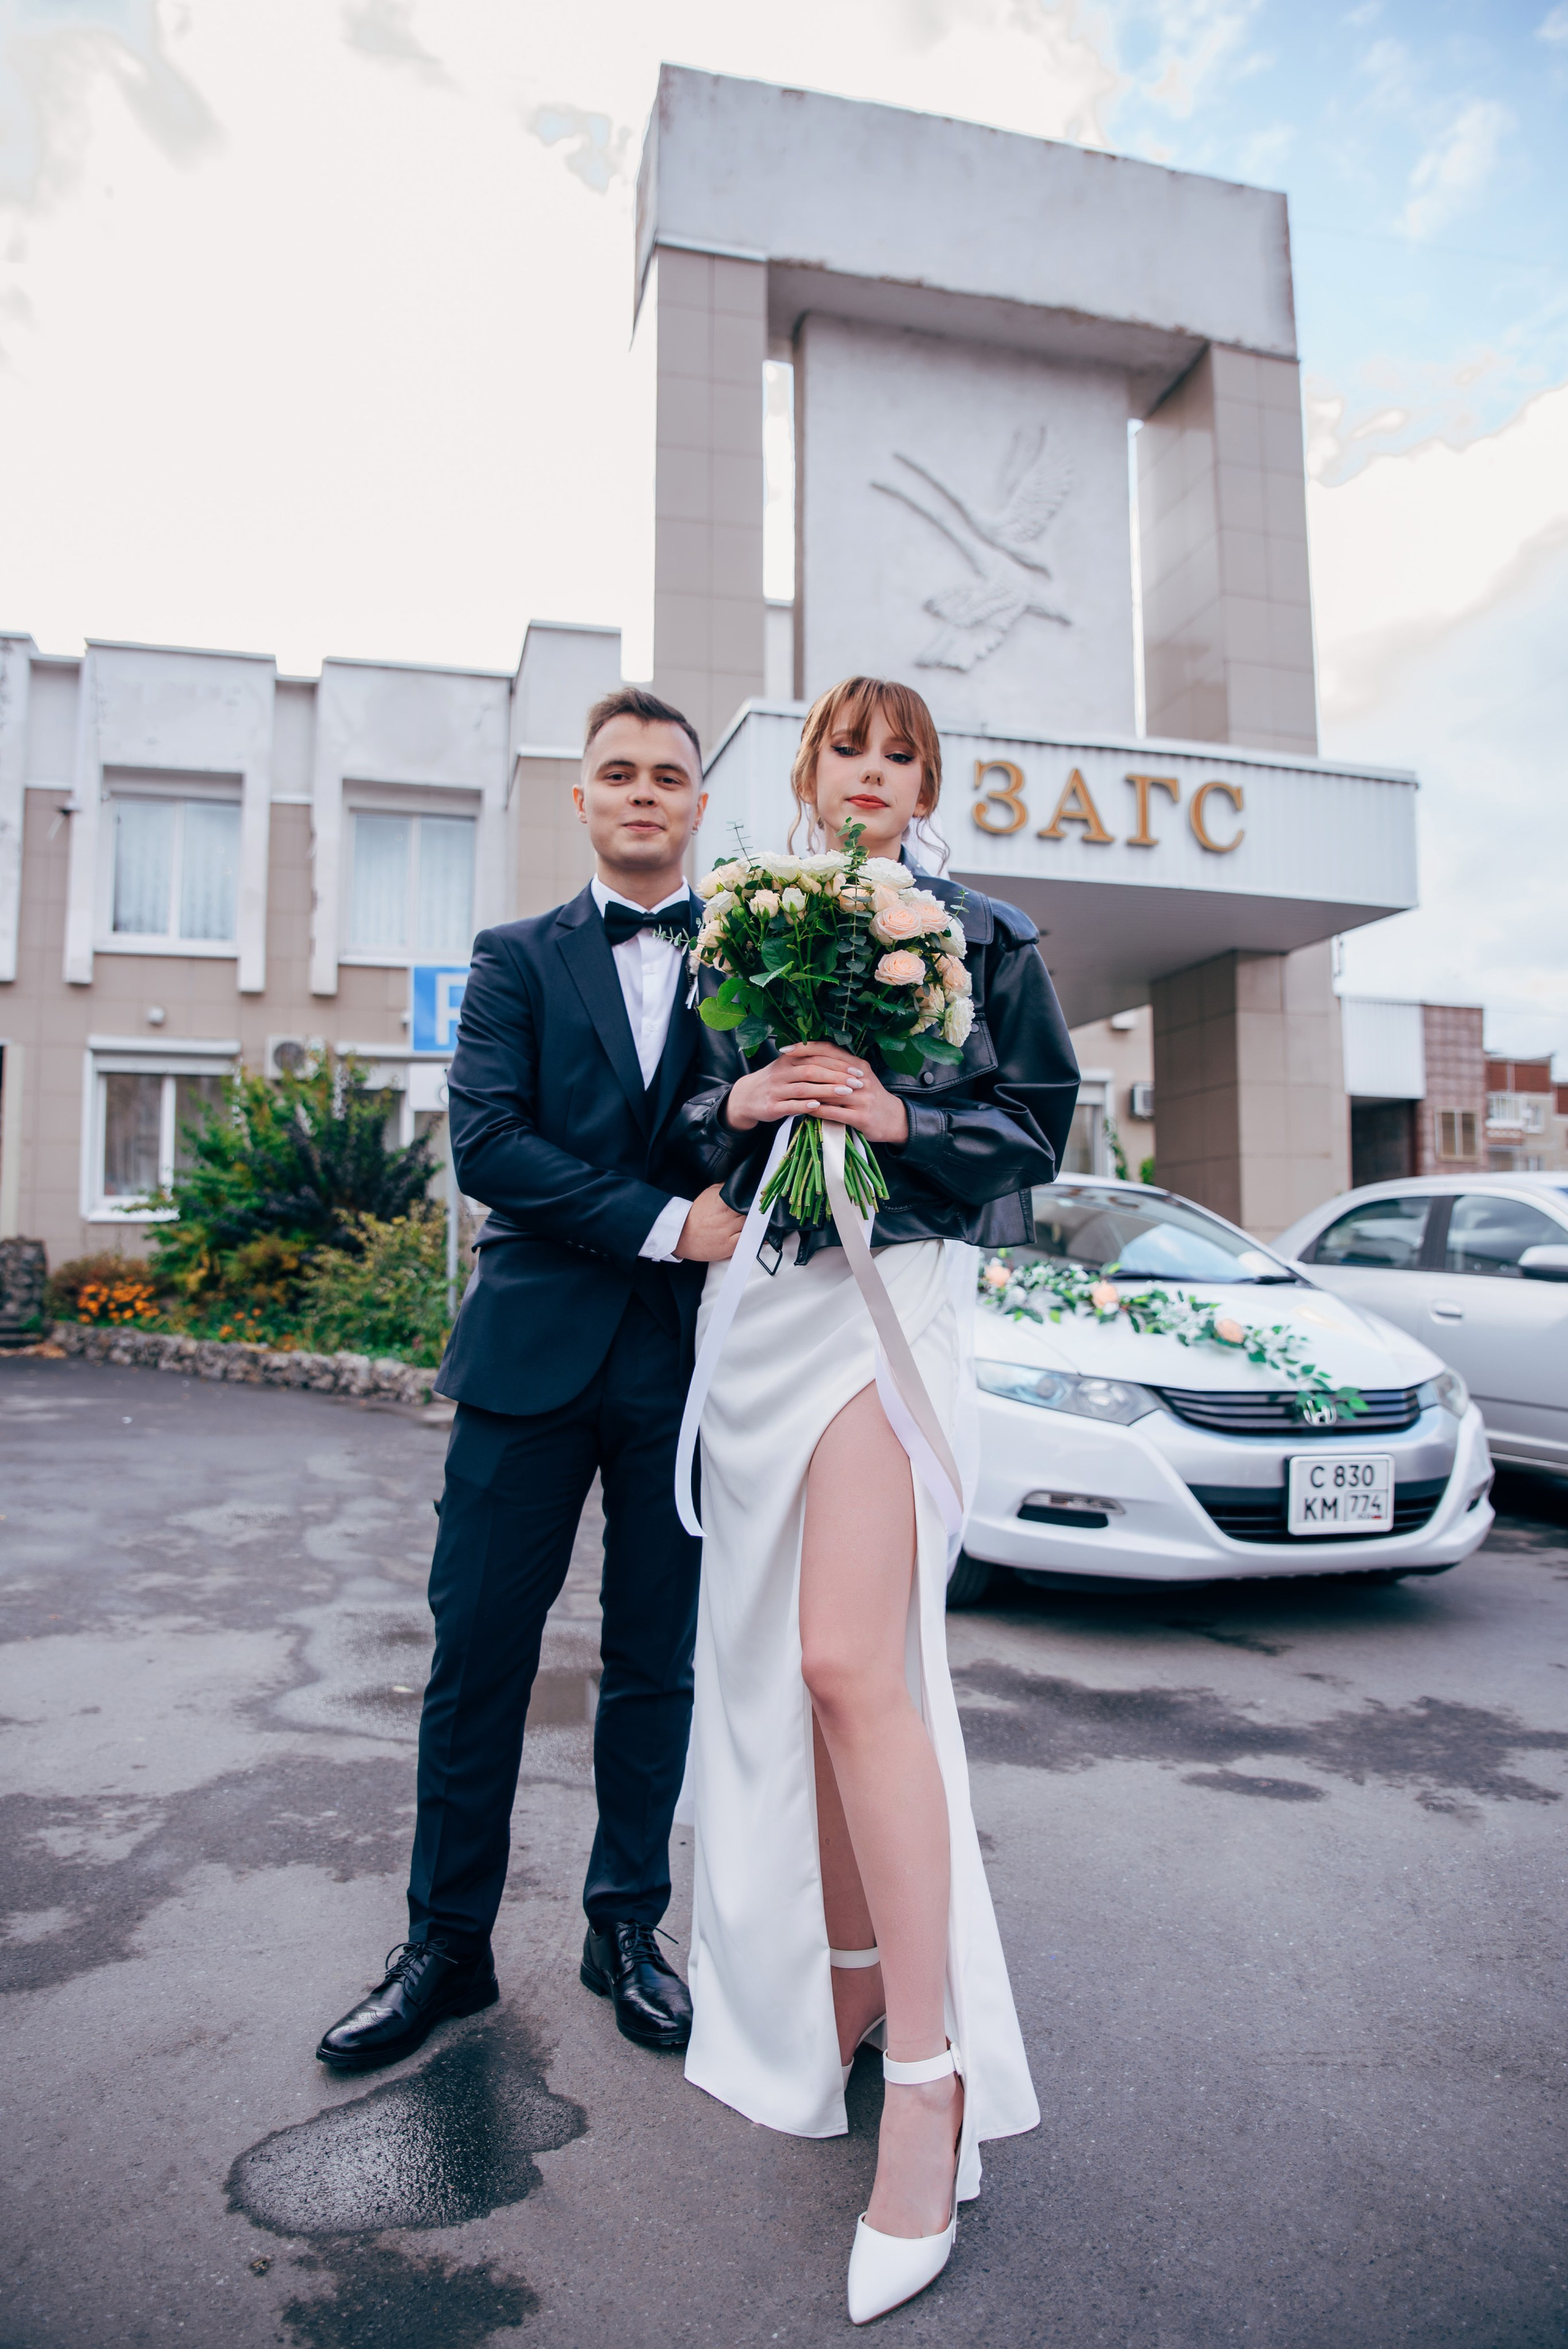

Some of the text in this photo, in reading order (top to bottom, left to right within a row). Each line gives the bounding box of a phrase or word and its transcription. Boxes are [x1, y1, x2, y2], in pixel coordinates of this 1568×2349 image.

[973, 760, 1245, 853] ЗАГС
[1334, 1465, 1374, 1487] 830
[1304, 1495, 1381, 1520] КМ 774
